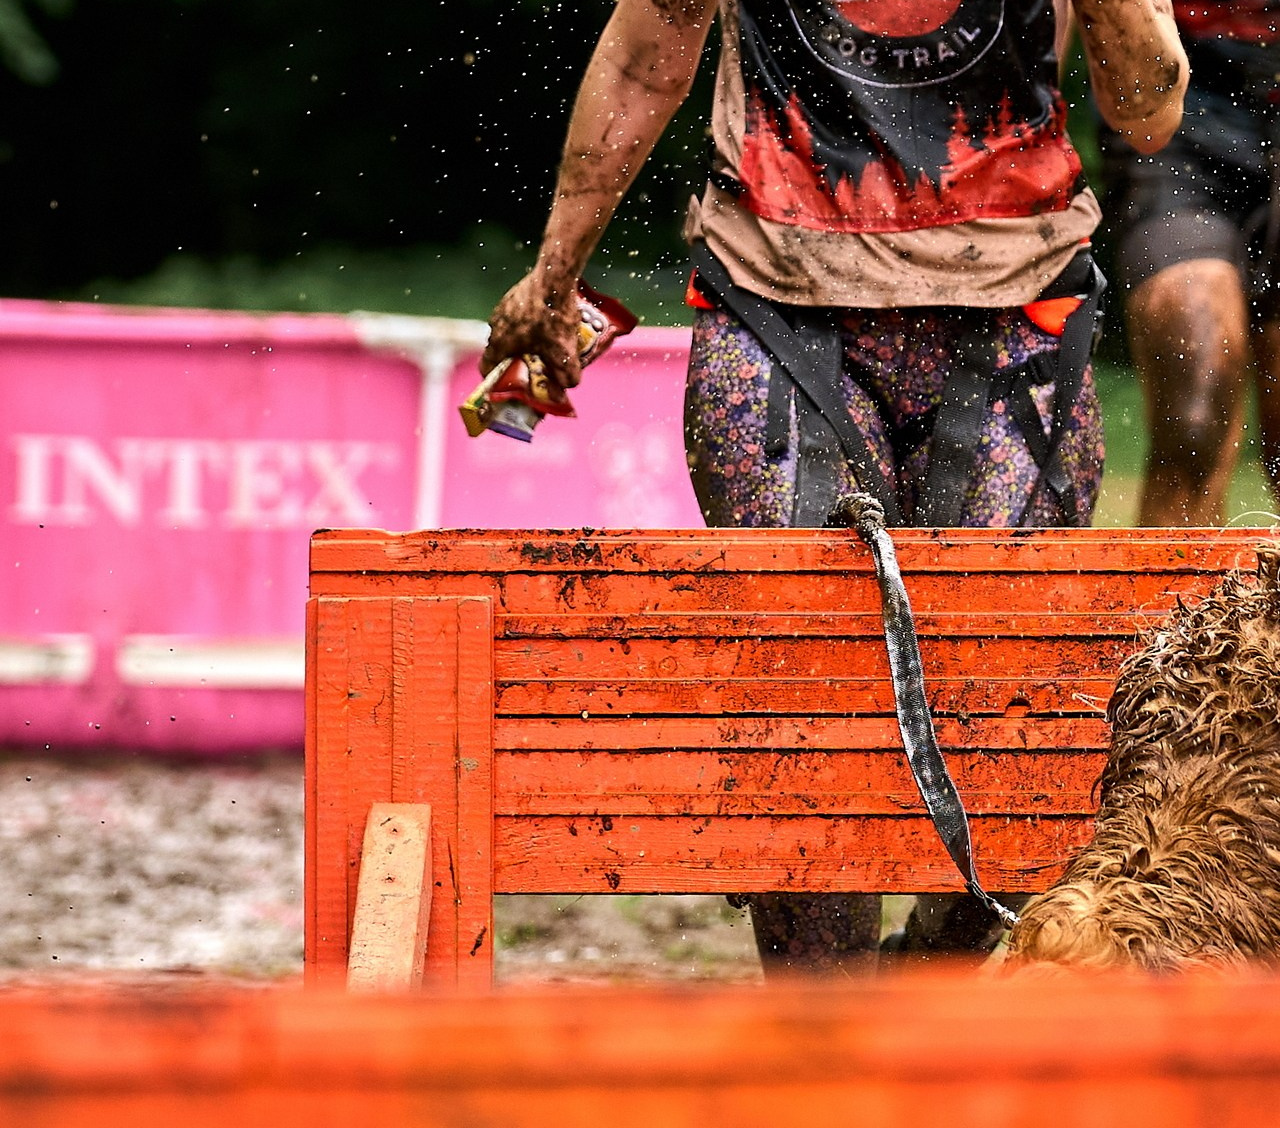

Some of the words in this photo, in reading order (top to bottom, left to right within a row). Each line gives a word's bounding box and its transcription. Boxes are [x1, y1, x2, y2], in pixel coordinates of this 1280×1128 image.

[821, 24, 878, 66] OG
[892, 26, 981, 69] TRAIL
[12, 433, 388, 530] INTEX
